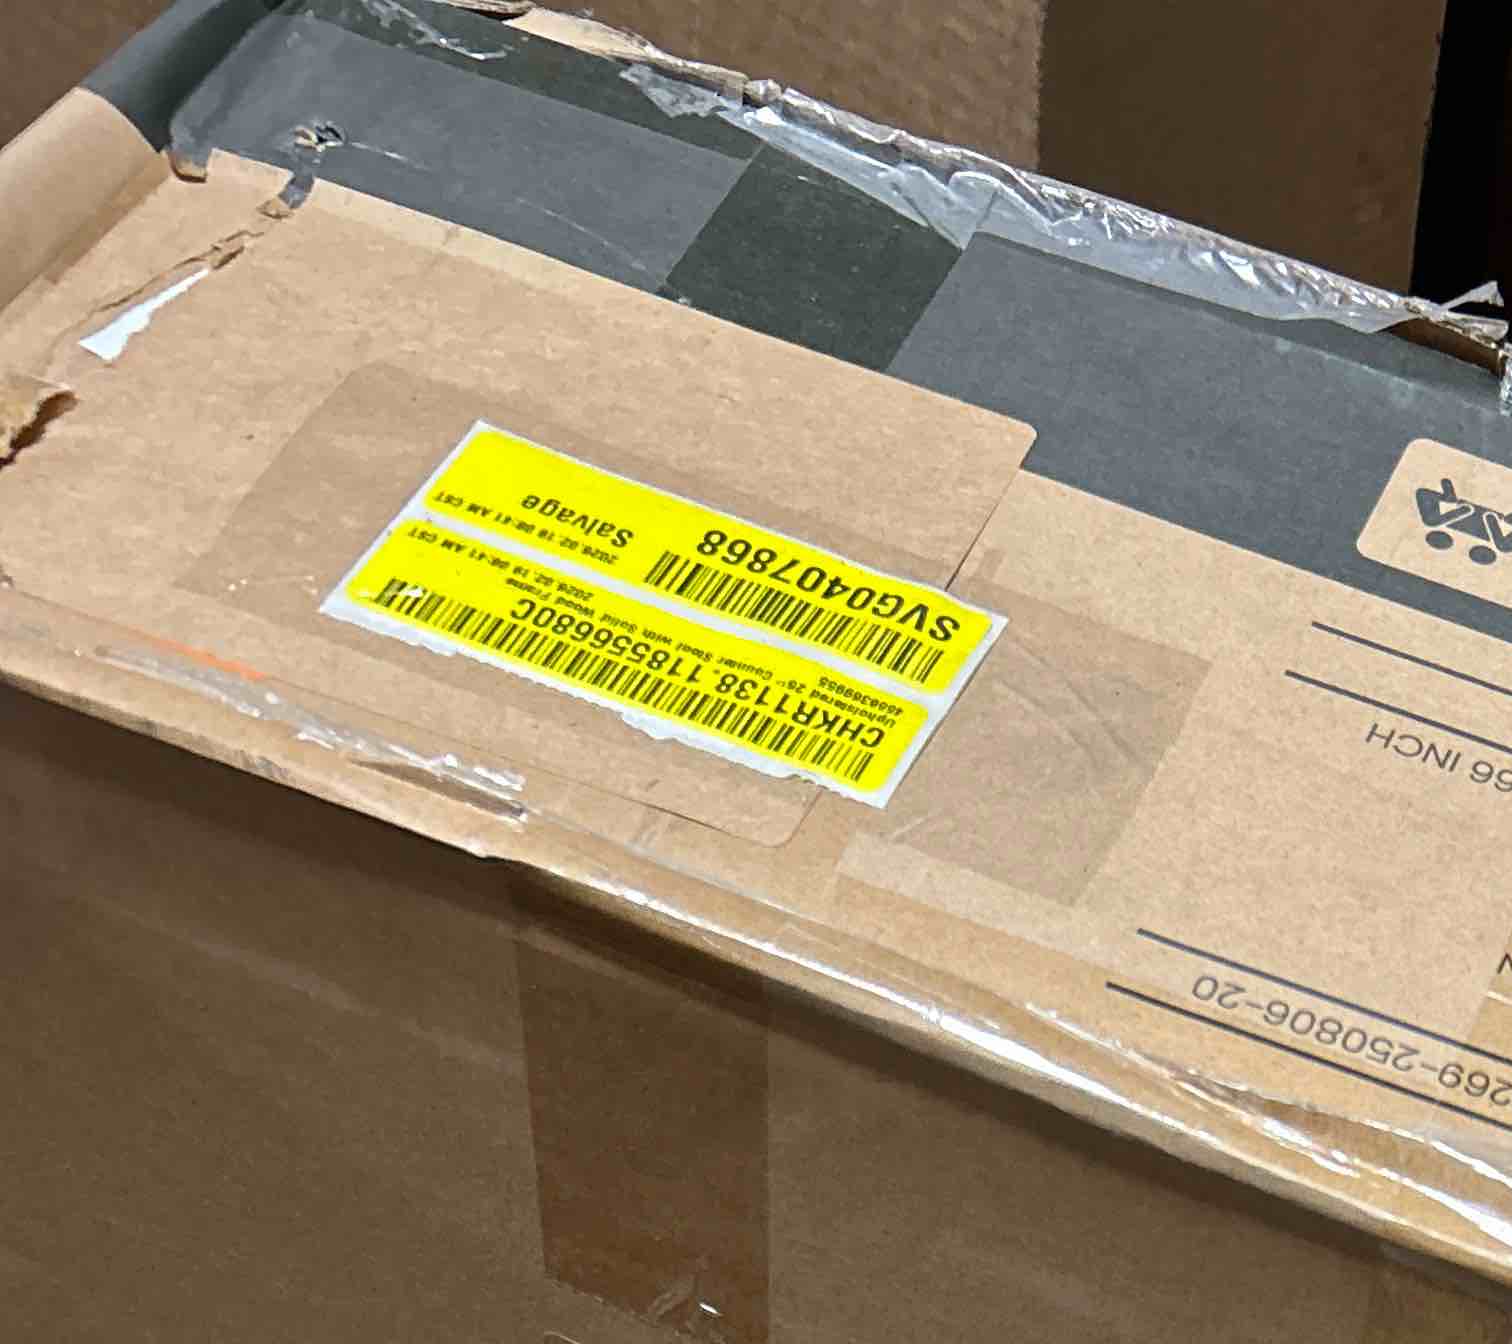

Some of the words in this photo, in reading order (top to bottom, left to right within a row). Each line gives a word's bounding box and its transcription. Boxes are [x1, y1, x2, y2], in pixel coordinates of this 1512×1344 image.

[521, 494, 634, 548] Salvage
[697, 529, 960, 641] SVG0407868
[641, 627, 673, 646] with
[510, 599, 885, 748] CHKR1138.118556680C
[1365, 722, 1461, 773] INCH
